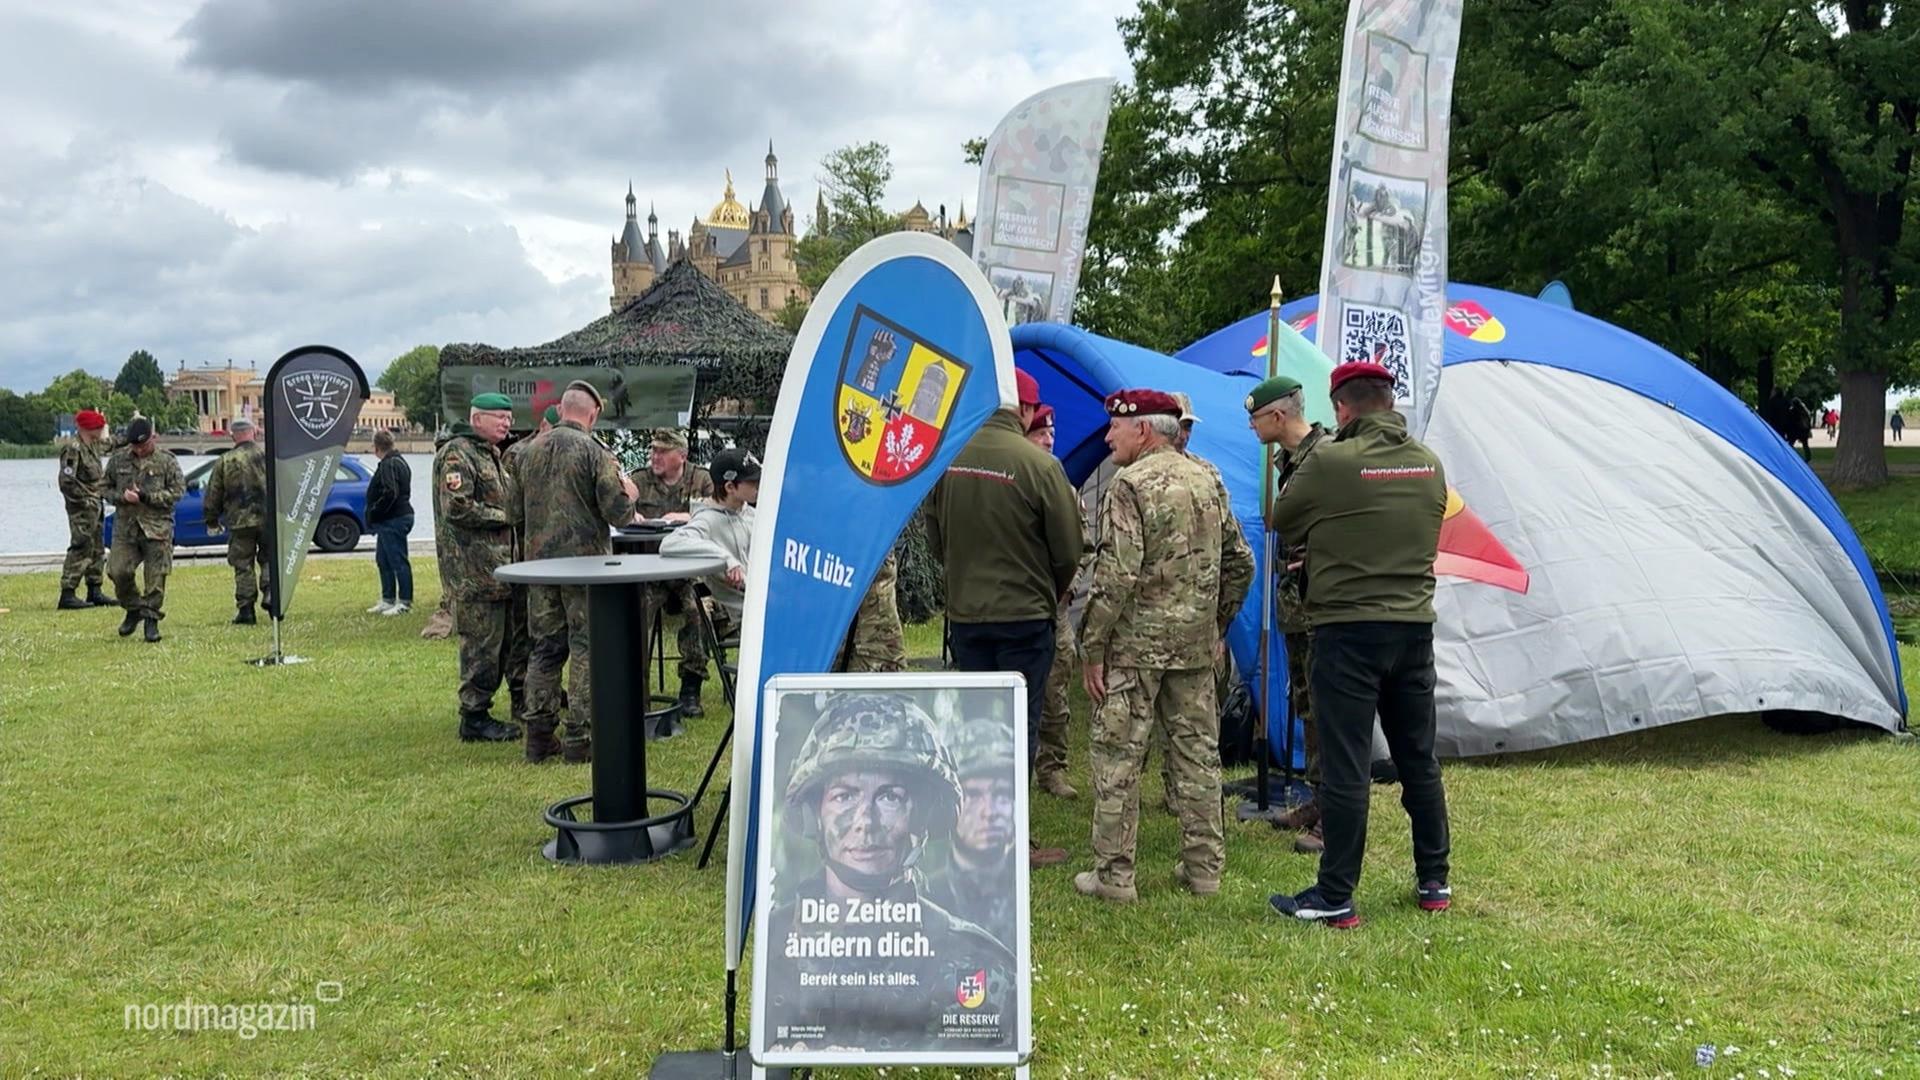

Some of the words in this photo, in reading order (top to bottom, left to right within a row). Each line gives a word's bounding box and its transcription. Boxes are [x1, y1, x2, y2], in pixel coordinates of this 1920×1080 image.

[785, 538, 810, 574] RK
[813, 549, 855, 588] Lübz
[801, 898, 840, 924] Die
[845, 897, 922, 924] Zeiten
[785, 931, 873, 958] ändern
[878, 932, 935, 957] dich.
[800, 972, 837, 986] Bereit
[840, 972, 866, 986] sein
[869, 972, 884, 986] ist
[887, 971, 919, 986] alles.
[943, 1014, 958, 1025] DIE
[960, 1014, 1000, 1025] RESERVE
